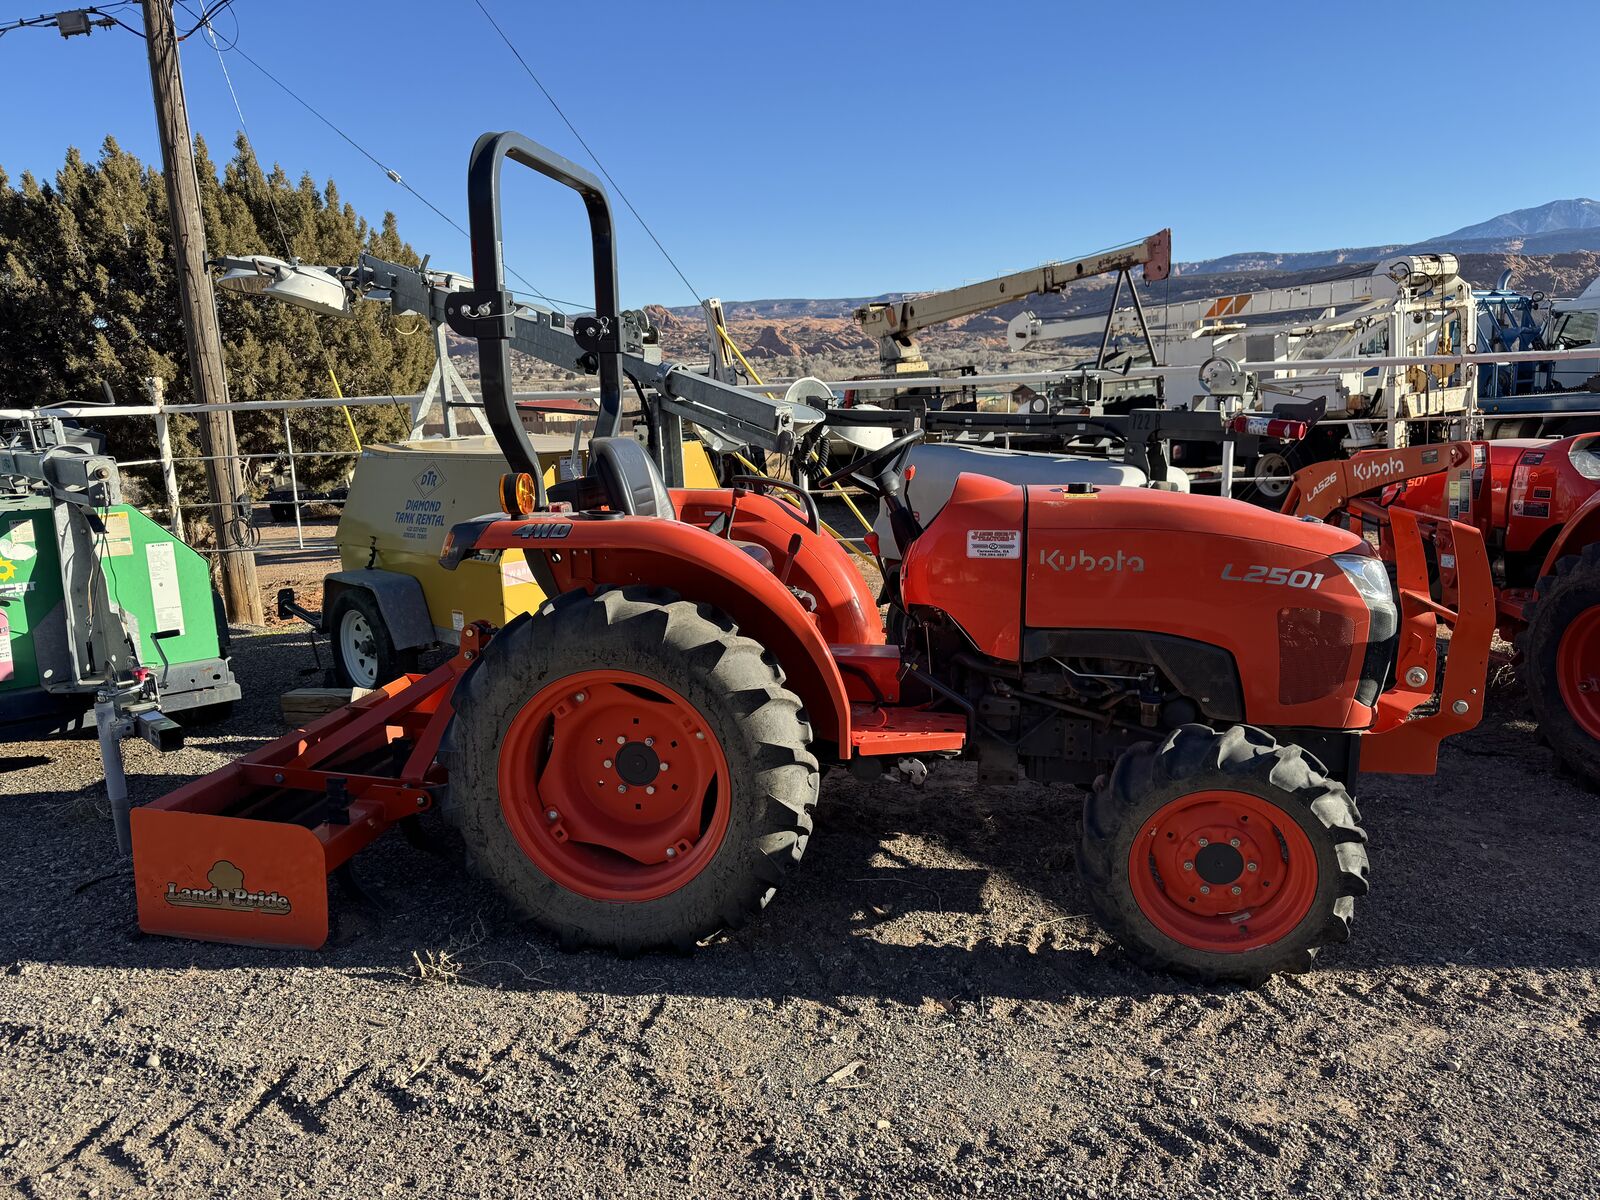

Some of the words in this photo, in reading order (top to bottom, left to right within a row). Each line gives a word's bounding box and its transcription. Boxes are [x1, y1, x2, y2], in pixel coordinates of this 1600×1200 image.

[420, 470, 438, 487] DTR
[1353, 456, 1405, 481] Kubota
[1306, 471, 1337, 502] LA526
[405, 499, 442, 512] DIAMOND
[394, 511, 415, 524] TANK
[415, 513, 445, 527] RENTAL
[512, 523, 574, 539] 4WD
[1039, 549, 1145, 572] Kubota
[1220, 563, 1325, 590] L2501
[166, 882, 219, 904] Land
[232, 888, 289, 909] Pride
